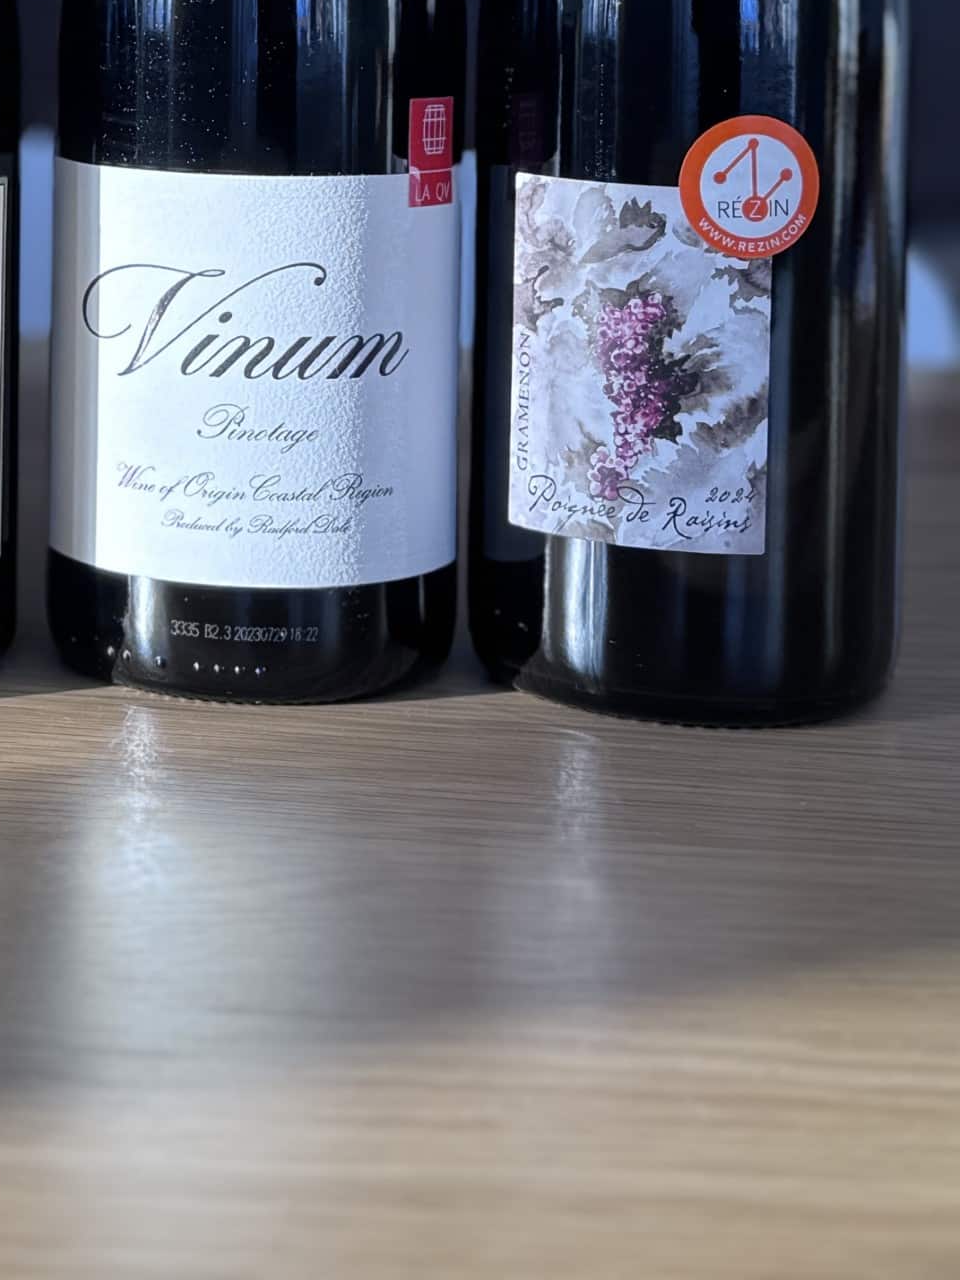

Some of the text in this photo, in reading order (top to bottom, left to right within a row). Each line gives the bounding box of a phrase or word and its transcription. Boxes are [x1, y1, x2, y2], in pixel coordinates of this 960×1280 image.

[416, 184, 430, 202] LA
[717, 196, 789, 219] RÉZIN
[699, 214, 807, 253] WWW.REZIN.COM
[82, 262, 409, 380] Vinum
[517, 332, 530, 471] GRAMENON
[197, 403, 319, 454] Pinotage
[116, 462, 394, 507] Wine of Origin Coastal Region
[705, 487, 757, 503] 2024
[161, 509, 352, 539] Produced by Radford Dale
[662, 497, 753, 540] Raisins
